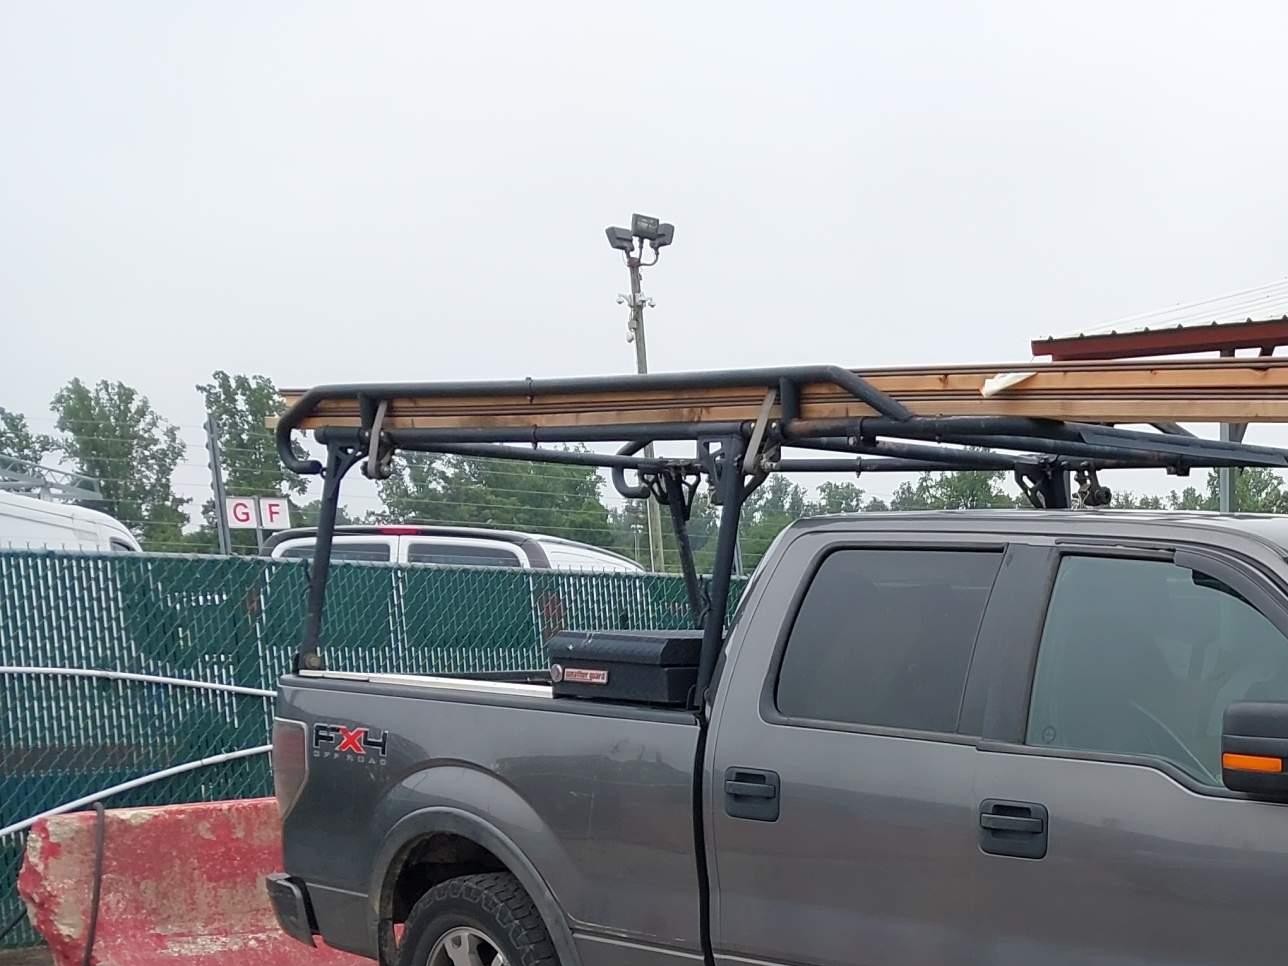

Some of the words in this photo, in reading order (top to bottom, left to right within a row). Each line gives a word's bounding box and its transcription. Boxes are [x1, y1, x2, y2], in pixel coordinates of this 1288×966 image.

[233, 502, 250, 523] G
[268, 503, 280, 523] F
[313, 723, 389, 757] FX4
